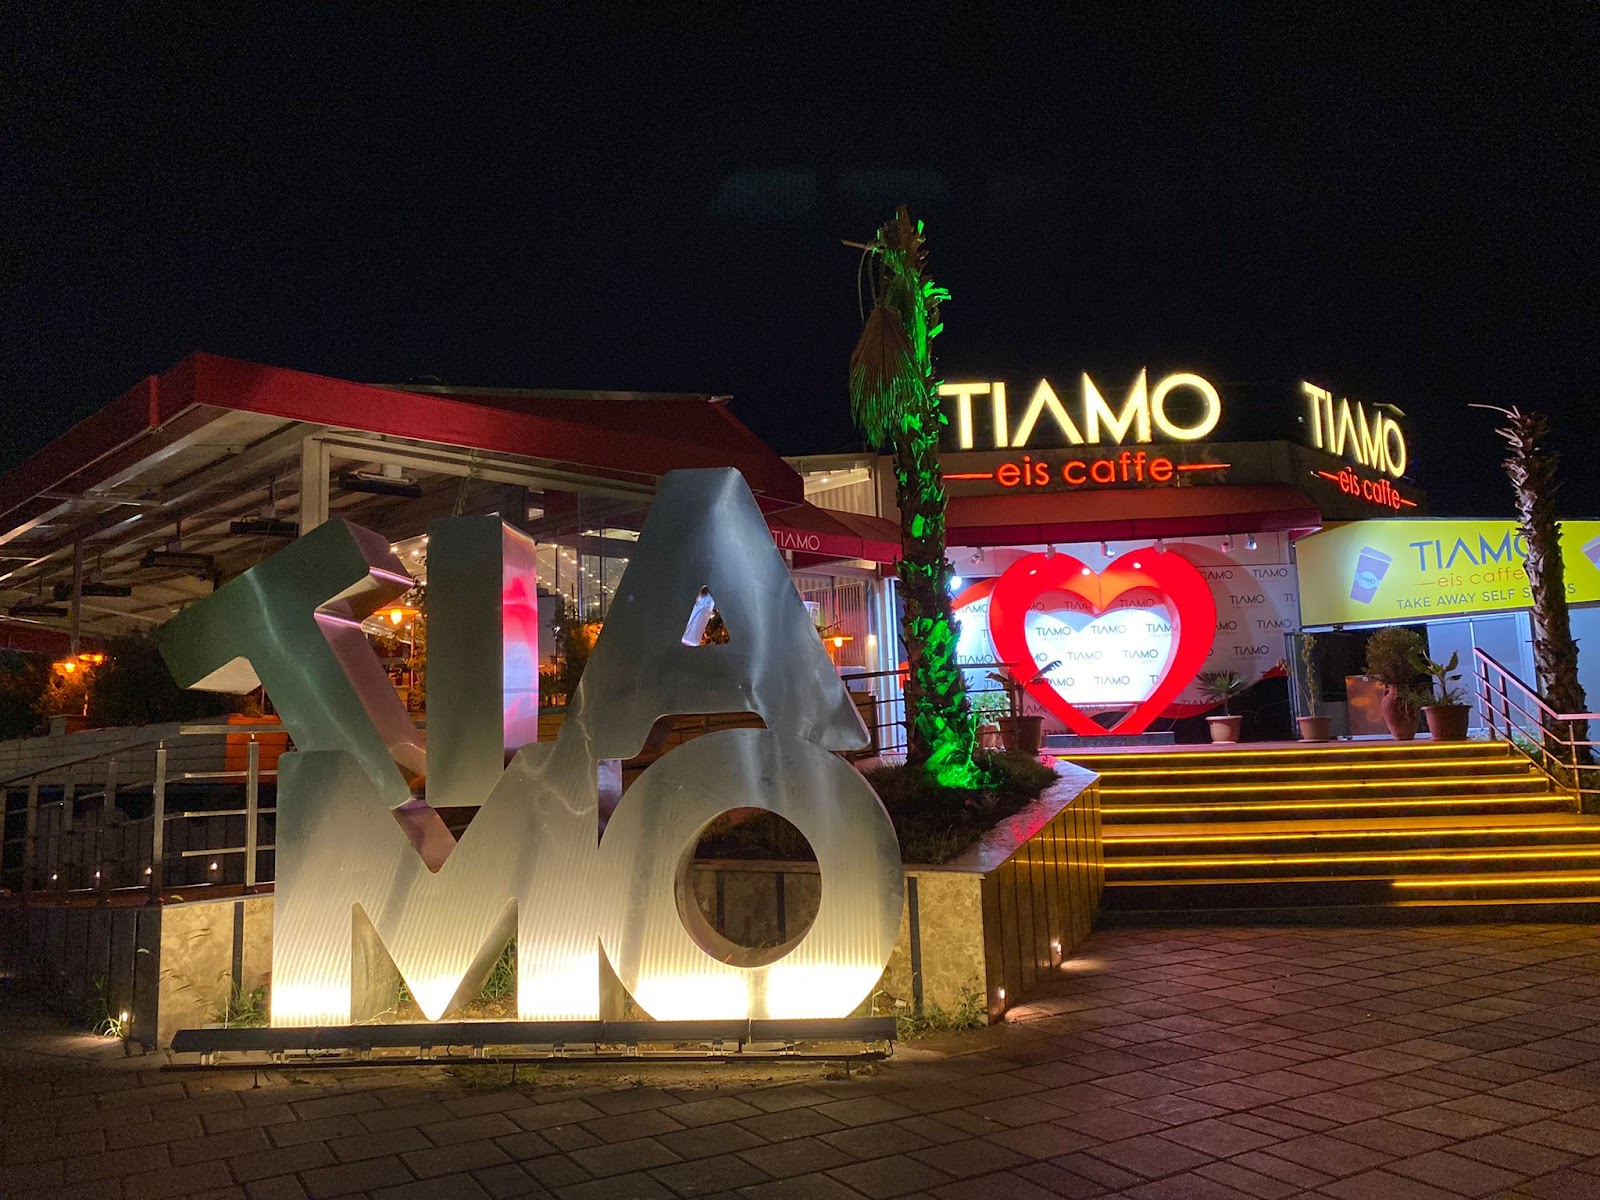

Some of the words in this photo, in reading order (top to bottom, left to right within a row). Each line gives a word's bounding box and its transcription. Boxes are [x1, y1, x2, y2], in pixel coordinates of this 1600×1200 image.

[938, 366, 1221, 449] TIAMO
[1303, 381, 1407, 478] TIAMO
[996, 455, 1050, 486] eis
[1062, 451, 1173, 484] caffe
[1339, 466, 1360, 496] eis
[1363, 478, 1401, 510] caffe
[771, 530, 820, 551] TIAMO
[1252, 568, 1288, 579] TIAMO
[1437, 573, 1462, 588] eis
[1469, 567, 1524, 585] caffe
[1118, 598, 1155, 608] TIAMO
[1229, 594, 1265, 604] TIAMO
[1397, 596, 1431, 610] TAKE
[1437, 592, 1476, 606] AWAY
[1482, 588, 1516, 602] SELF
[1145, 622, 1172, 633] TIAM
[1256, 618, 1292, 629] TIAMO
[1035, 626, 1072, 637] TIAMO
[1090, 624, 1127, 635] TIAMO
[1067, 650, 1103, 661] TIAMO
[1123, 648, 1159, 659] TIAMO
[1233, 645, 1269, 656] TIAMO
[1094, 675, 1130, 686] TIAMO
